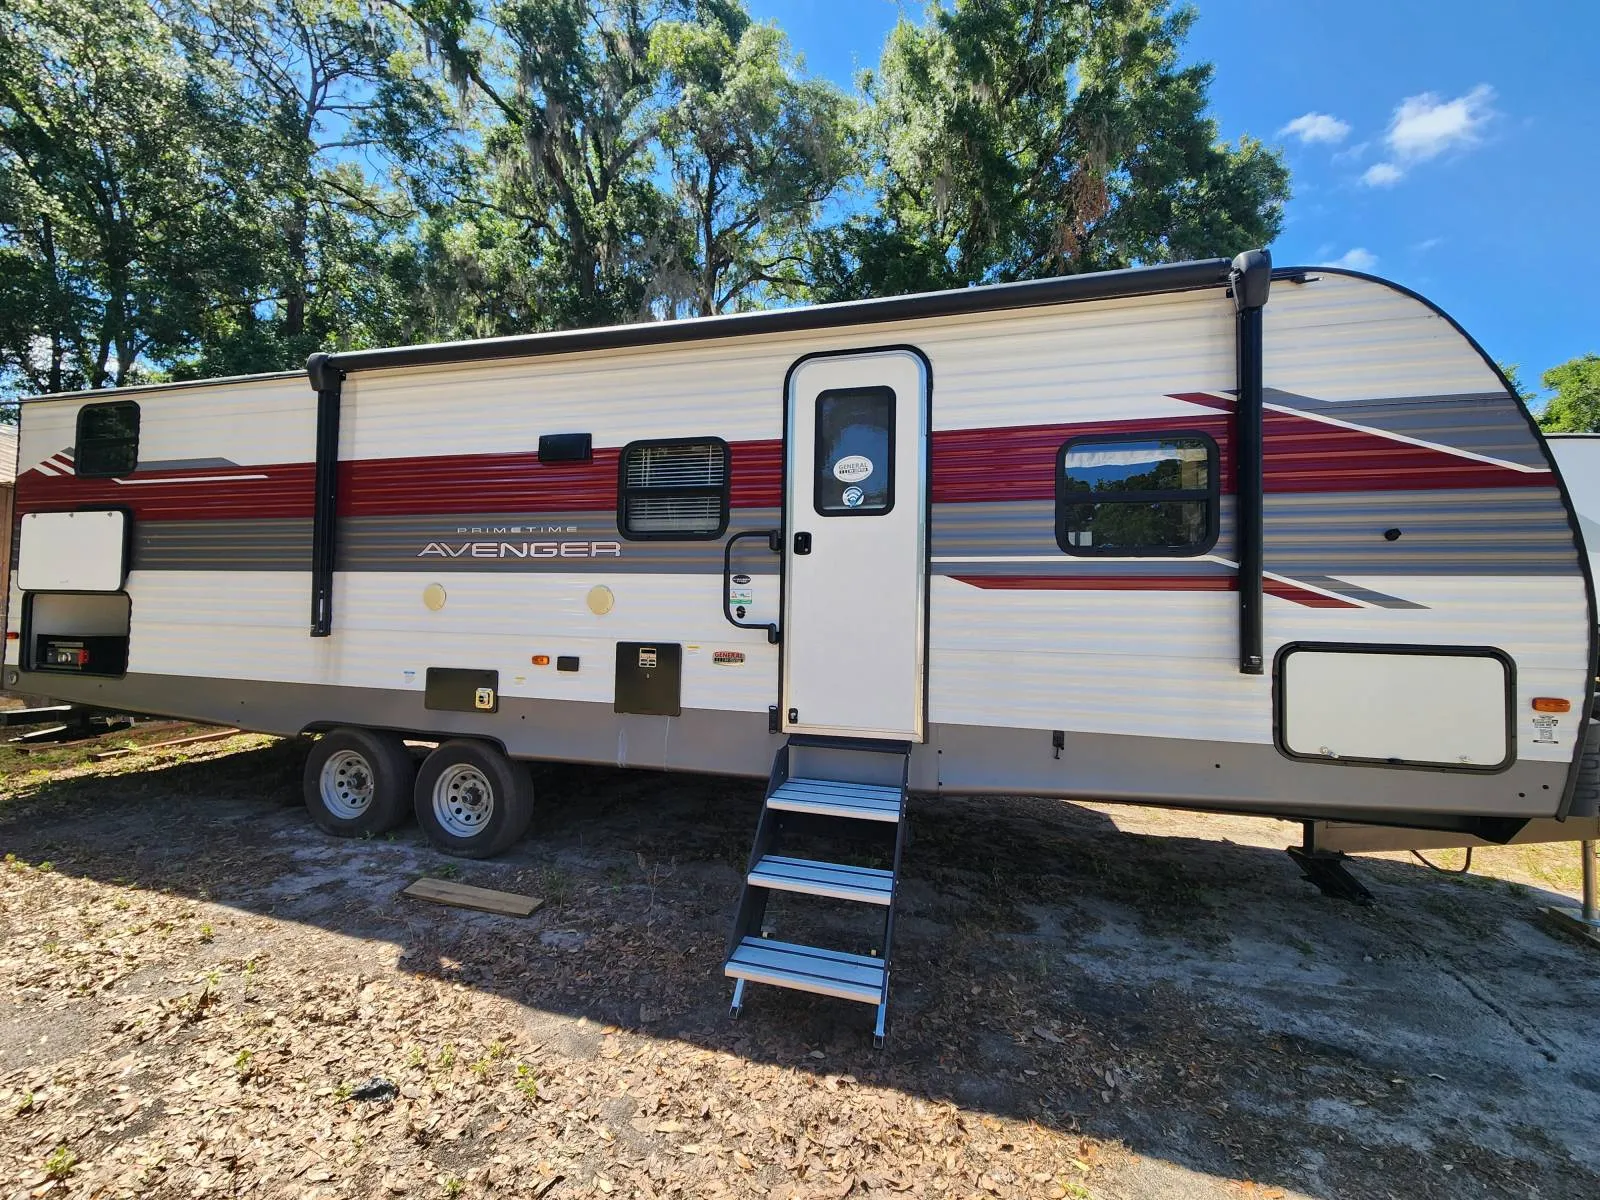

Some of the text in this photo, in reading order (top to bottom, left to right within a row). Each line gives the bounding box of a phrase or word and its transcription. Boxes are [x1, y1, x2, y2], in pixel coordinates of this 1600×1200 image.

[838, 462, 868, 470] GENERAL
[457, 526, 578, 534] PRIMETIME
[416, 541, 622, 558] AVENGER
